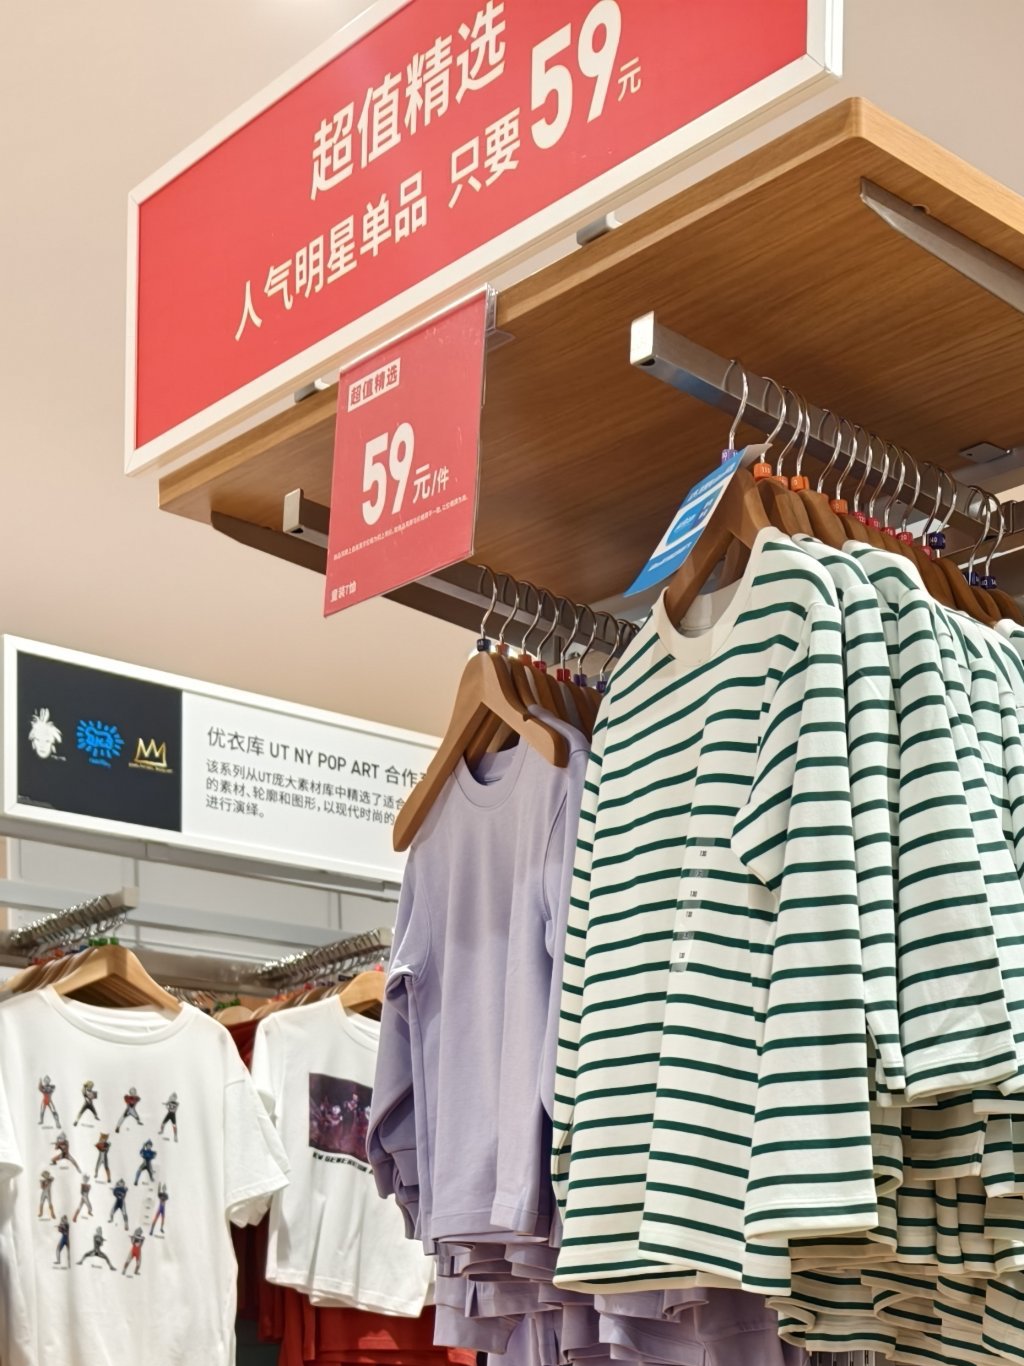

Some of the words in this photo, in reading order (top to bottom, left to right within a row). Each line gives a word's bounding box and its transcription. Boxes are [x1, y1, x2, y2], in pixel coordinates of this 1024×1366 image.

[311, 0, 506, 200] 超值精选
[234, 171, 427, 341] 人气明星单品
[350, 365, 398, 405] 超值精选
[207, 726, 265, 756] 优衣库
[270, 742, 289, 760] UT
[294, 747, 314, 765] NY
[318, 752, 346, 772] POP
[351, 760, 380, 779] ART
